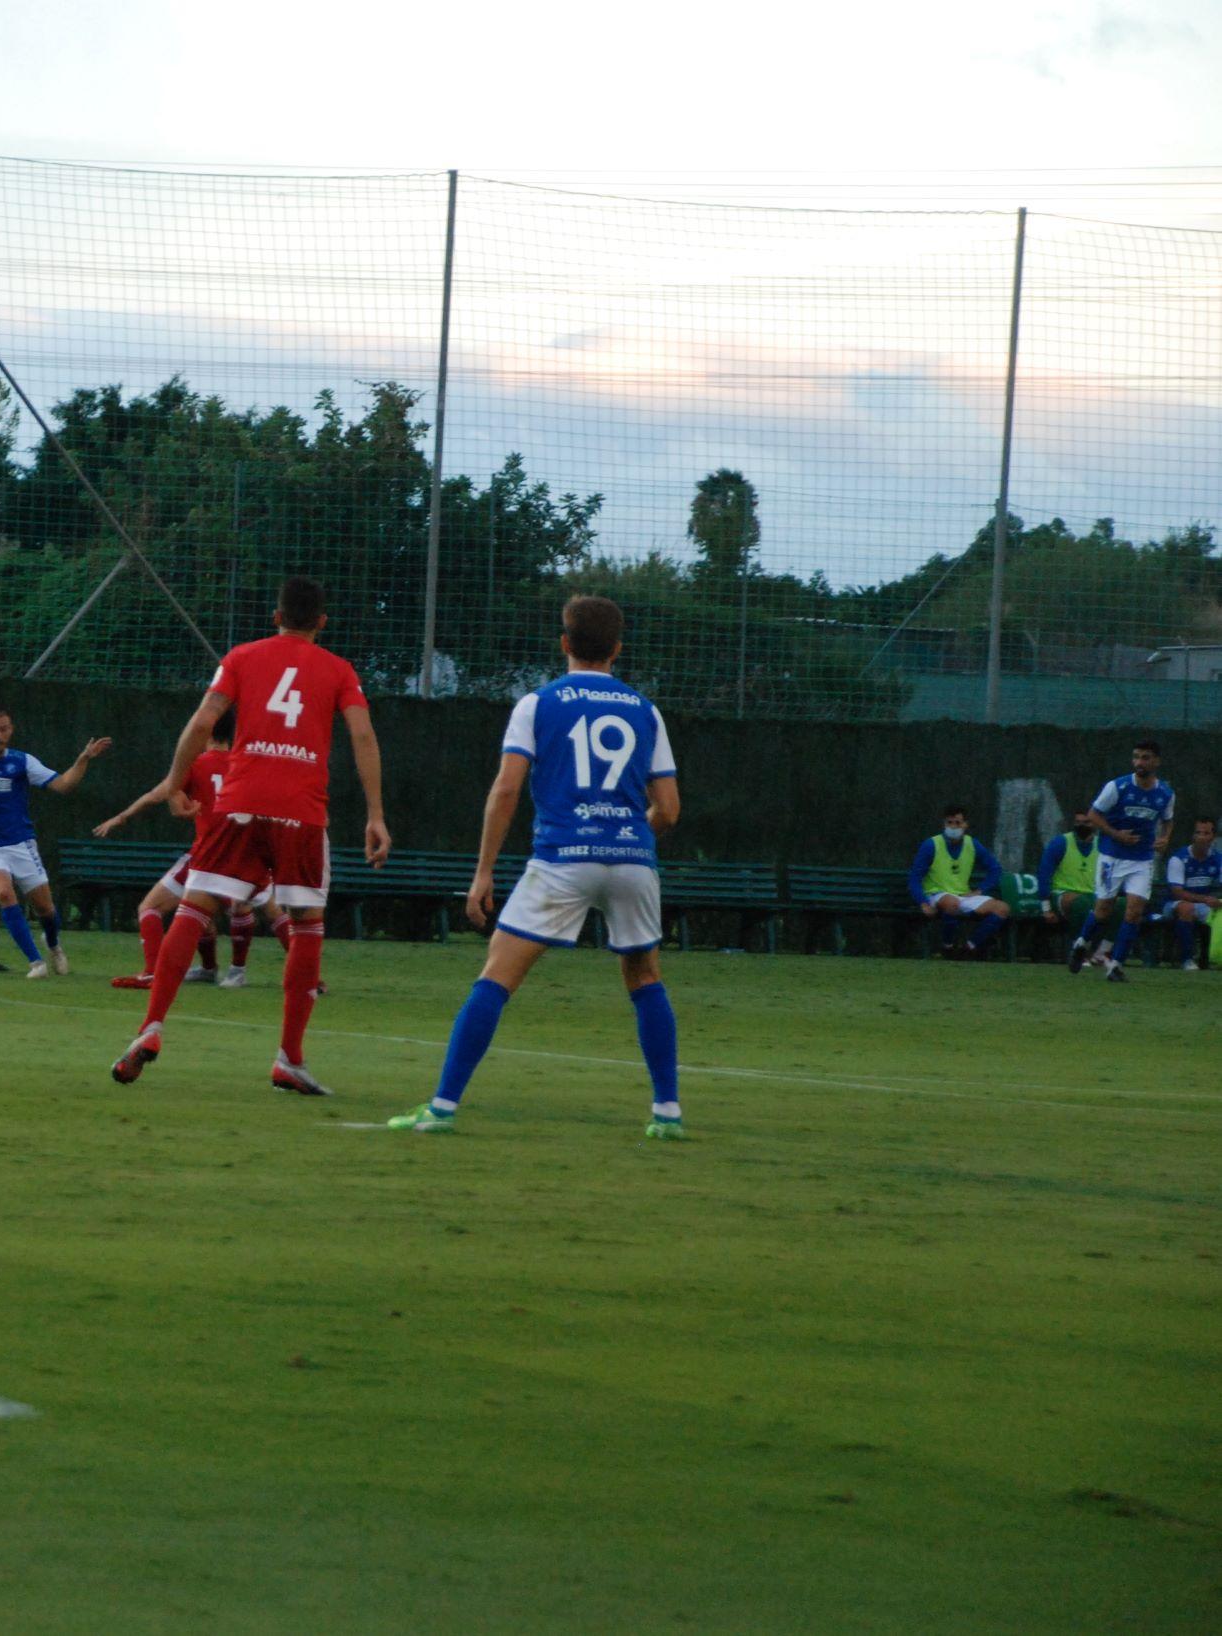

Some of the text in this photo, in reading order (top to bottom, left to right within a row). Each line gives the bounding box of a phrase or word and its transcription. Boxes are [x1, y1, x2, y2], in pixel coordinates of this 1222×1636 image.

[266, 667, 304, 728] 4
[253, 741, 308, 760] MAYMA
[567, 714, 637, 790] 19
